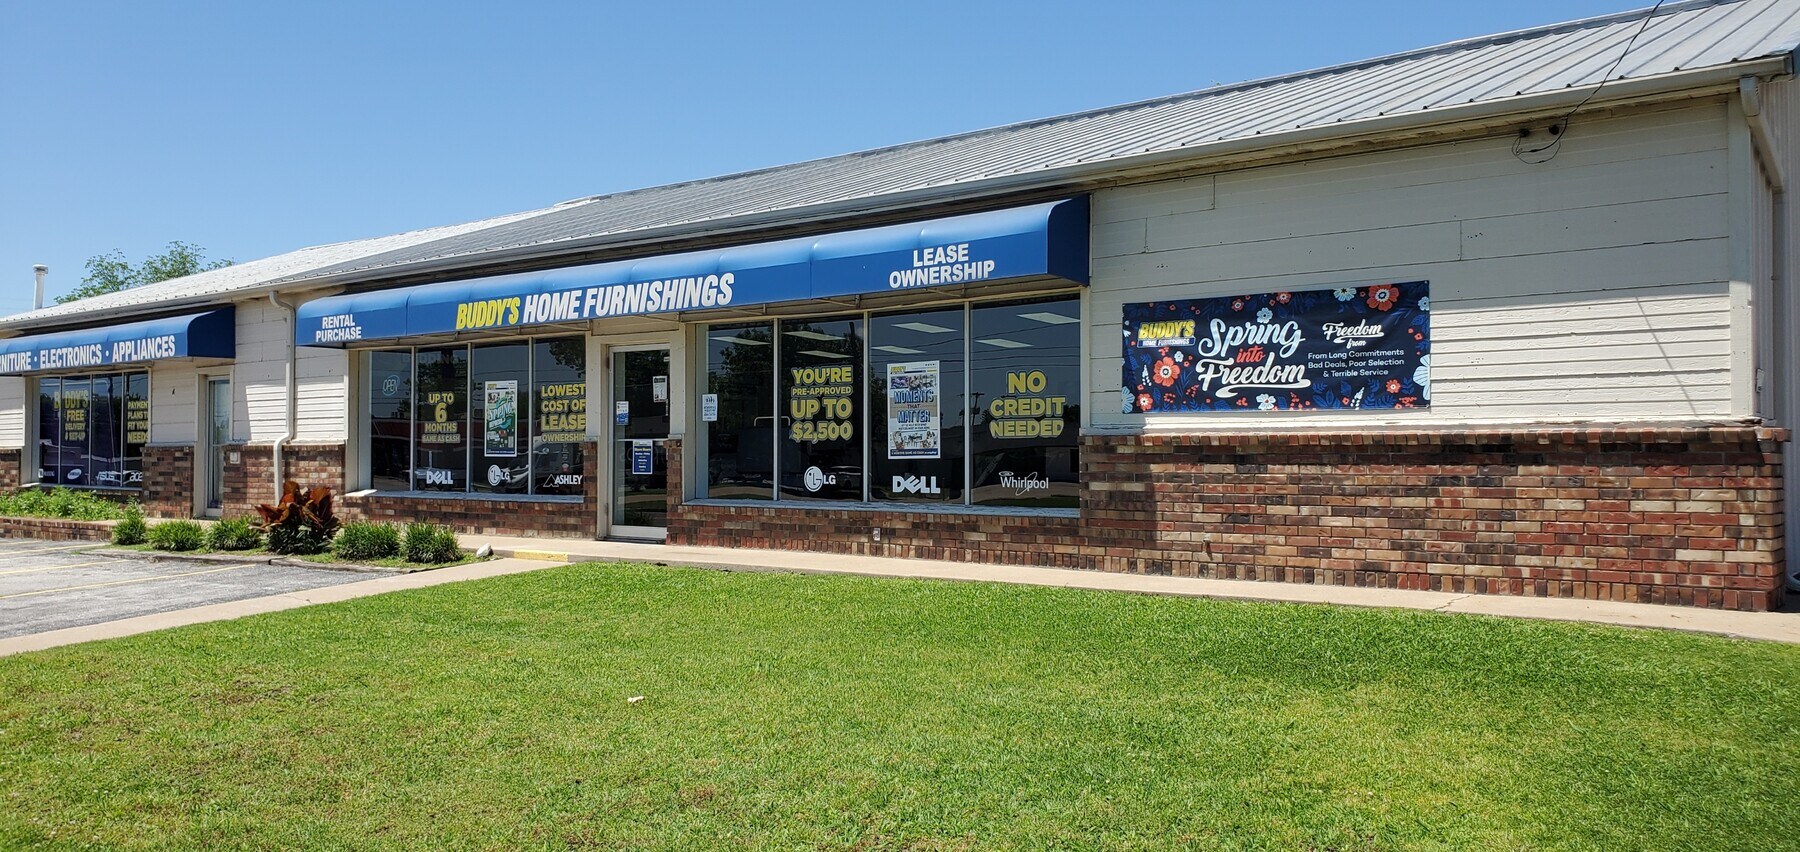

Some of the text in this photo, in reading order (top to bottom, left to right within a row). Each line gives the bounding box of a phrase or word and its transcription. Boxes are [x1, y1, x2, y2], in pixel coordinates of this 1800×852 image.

[913, 243, 969, 267] LEASE
[889, 260, 995, 288] OWNERSHIP
[456, 272, 734, 330] BUDDY'S HOME FURNISHINGS
[322, 314, 355, 329] RENTAL
[316, 327, 361, 342] PURCHASE
[1139, 321, 1194, 339] BUDDY'S
[1322, 319, 1384, 343] Freedom
[1198, 318, 1305, 358] Spring
[1346, 338, 1366, 349] from
[0, 335, 175, 372] NITURE ELECTRONICS APPLIANCES
[1237, 346, 1266, 363] into
[1329, 351, 1347, 359] Long
[1349, 349, 1404, 358] Commitments
[1308, 361, 1323, 369] Bad
[1325, 360, 1347, 369] Deals,
[1368, 358, 1404, 367] Selection
[793, 367, 852, 384] YOU'RE
[1195, 352, 1311, 398] Freedom
[1331, 369, 1358, 377] Terrible
[1360, 368, 1388, 376] Service
[1008, 371, 1047, 394] NO
[542, 384, 586, 397] LOWEST
[792, 386, 851, 396] PRE-APPROVED
[894, 388, 935, 405] MOMENTS
[127, 401, 148, 410] PAYMEN
[429, 393, 454, 404] UP TO
[542, 399, 586, 412] COST OF
[435, 402, 447, 423] 6
[792, 397, 851, 418] UP TO
[990, 397, 1066, 417] CREDIT
[66, 410, 85, 421] FREE
[542, 414, 586, 429] LEASE
[897, 409, 931, 423] MATTER
[65, 422, 86, 431] DELIVERY
[425, 422, 457, 433] MONTHS
[792, 422, 852, 442] $2,500
[989, 421, 1064, 437] NEEDED
[422, 434, 460, 444] SAME AS CASH
[129, 471, 143, 481] ace
[426, 470, 454, 485] DELL
[556, 475, 583, 485] ASHLEY
[823, 475, 837, 485] LG
[1000, 476, 1049, 491] Whirlpool
[892, 475, 941, 494] DELL
